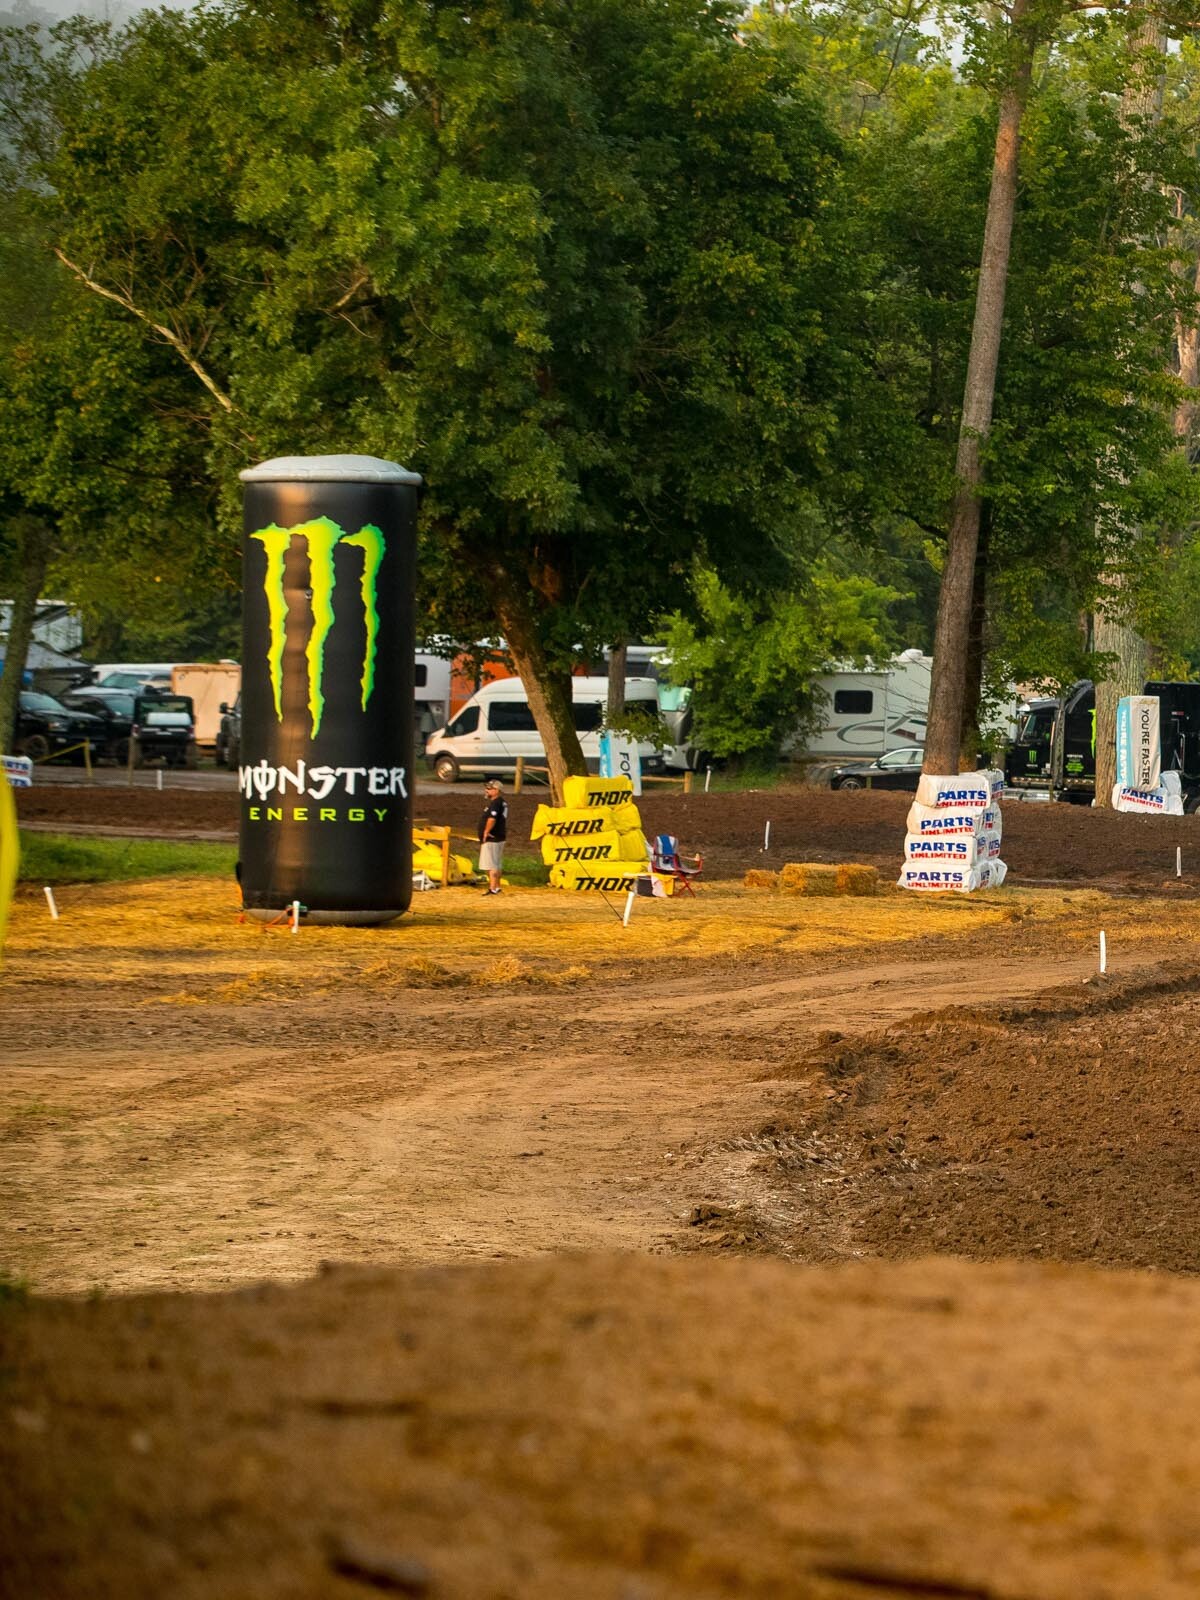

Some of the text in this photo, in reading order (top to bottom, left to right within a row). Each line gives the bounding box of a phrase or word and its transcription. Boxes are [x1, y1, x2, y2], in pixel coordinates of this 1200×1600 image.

[1141, 749, 1150, 786] FASTER
[239, 759, 408, 801] MONSTER
[587, 790, 632, 806] THOR
[937, 790, 987, 801] PARTS
[1121, 795, 1163, 809] UNLIMITED
[1122, 788, 1163, 803] PARTS
[936, 800, 987, 808] UNLIMITED
[249, 806, 388, 822] ENERGY
[547, 818, 604, 836] THOR
[921, 817, 974, 829] PARTS
[921, 827, 975, 835] UNLIMITED
[554, 845, 612, 862] THOR
[910, 842, 967, 852] PARTS
[910, 852, 967, 860] UNLIMITED
[906, 871, 963, 881] PARTS
[575, 877, 635, 891] THOR
[907, 881, 963, 889] UNLIMITED
